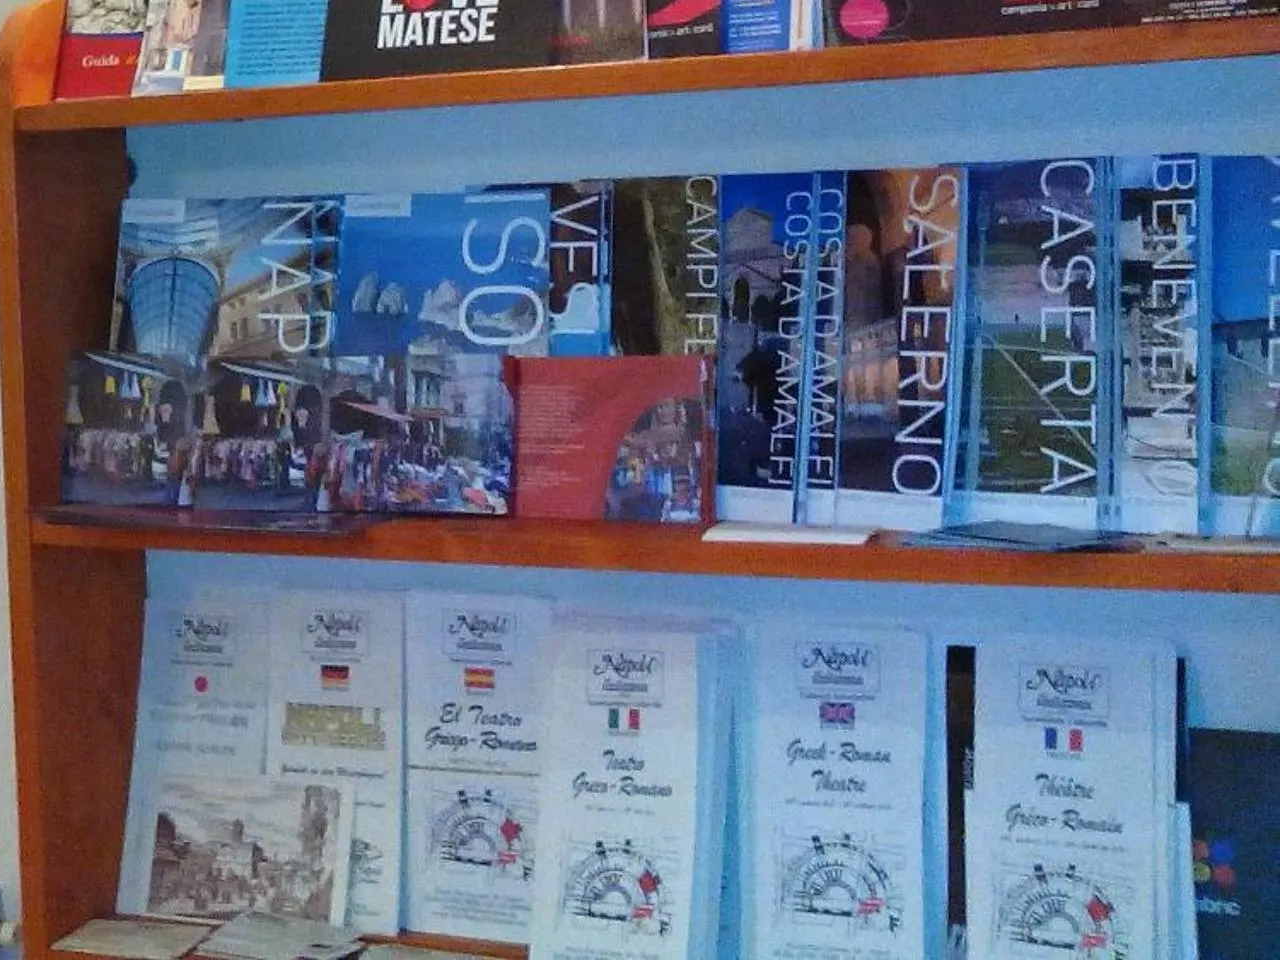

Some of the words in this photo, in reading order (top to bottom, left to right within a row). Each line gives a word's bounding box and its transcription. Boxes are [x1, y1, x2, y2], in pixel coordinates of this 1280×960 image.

[82, 53, 120, 69] Guida
[377, 7, 499, 49] MATESE
[684, 176, 718, 299] CAMPI
[778, 191, 812, 306] COSTA
[892, 174, 960, 496] SALERNO
[1040, 159, 1097, 493] CASERTA
